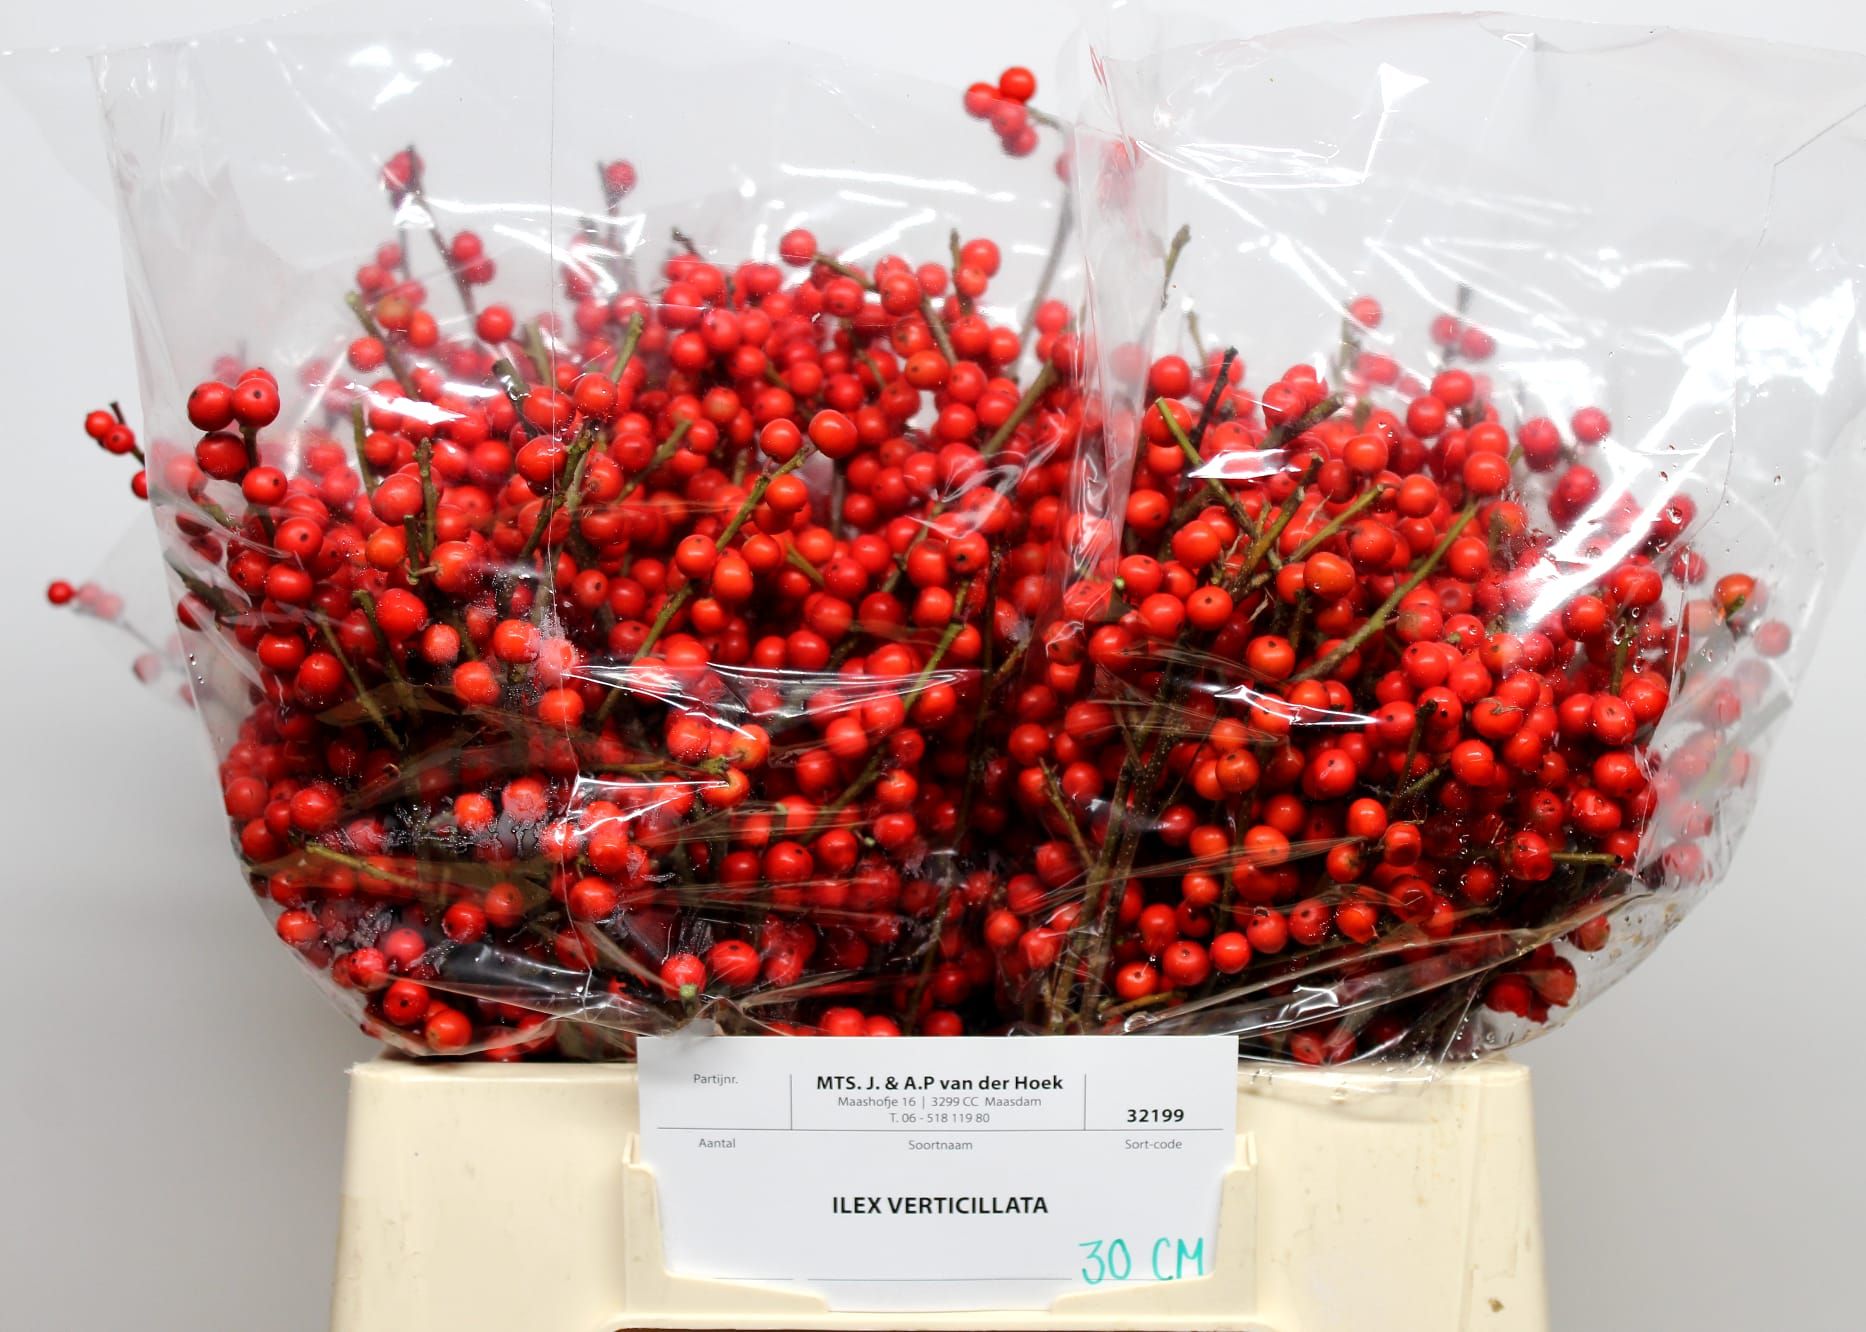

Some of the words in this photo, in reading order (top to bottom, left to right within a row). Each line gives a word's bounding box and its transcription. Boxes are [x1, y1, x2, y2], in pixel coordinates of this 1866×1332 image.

[693, 1073, 739, 1088] Partijnr.
[816, 1075, 862, 1091] MTS.
[865, 1075, 881, 1091] J.
[884, 1075, 899, 1091] &
[903, 1075, 936, 1091] A.P
[939, 1079, 974, 1091] van
[977, 1074, 1011, 1091] der
[1014, 1074, 1065, 1091] Hoek
[837, 1096, 899, 1109] Maashofje
[902, 1096, 917, 1107] 16
[931, 1096, 961, 1107] 3299
[962, 1096, 979, 1107] CC
[984, 1096, 1042, 1107] Maasdam
[889, 1112, 899, 1123] T.
[901, 1112, 917, 1124] 06
[927, 1112, 949, 1124] 518
[952, 1112, 973, 1124] 119
[975, 1112, 991, 1124] 80
[1126, 1108, 1185, 1124] 32199
[698, 1137, 736, 1149] Aantal
[908, 1139, 973, 1151] Soortnaam
[1124, 1138, 1183, 1150] Sort-code
[832, 1196, 883, 1215] ILEX
[886, 1196, 1049, 1215] VERTICILLATA
[1078, 1238, 1133, 1285] 30
[1151, 1236, 1205, 1281] CM
